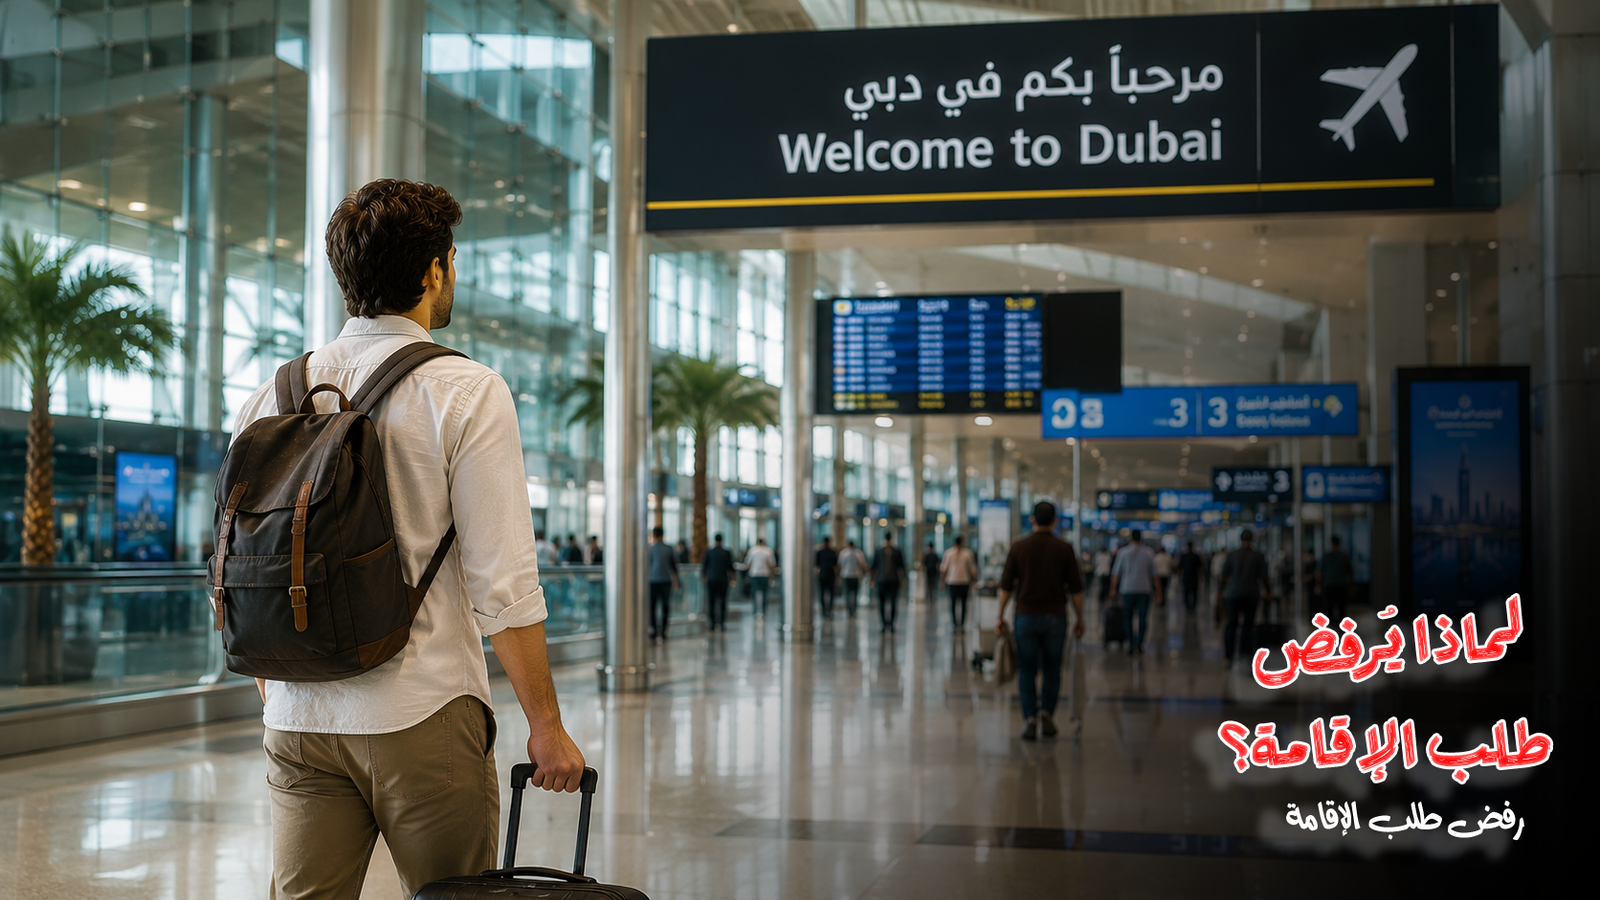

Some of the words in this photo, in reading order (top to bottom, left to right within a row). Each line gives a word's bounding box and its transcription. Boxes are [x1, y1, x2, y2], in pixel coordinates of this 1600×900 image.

[844, 74, 922, 121] دبي
[936, 61, 1003, 119] في
[1015, 56, 1094, 113] بكم
[778, 129, 994, 175] Welcome
[1010, 128, 1061, 167] to
[1080, 118, 1222, 165] Dubai
[1168, 397, 1189, 428] 3
[1207, 396, 1229, 428] 3
